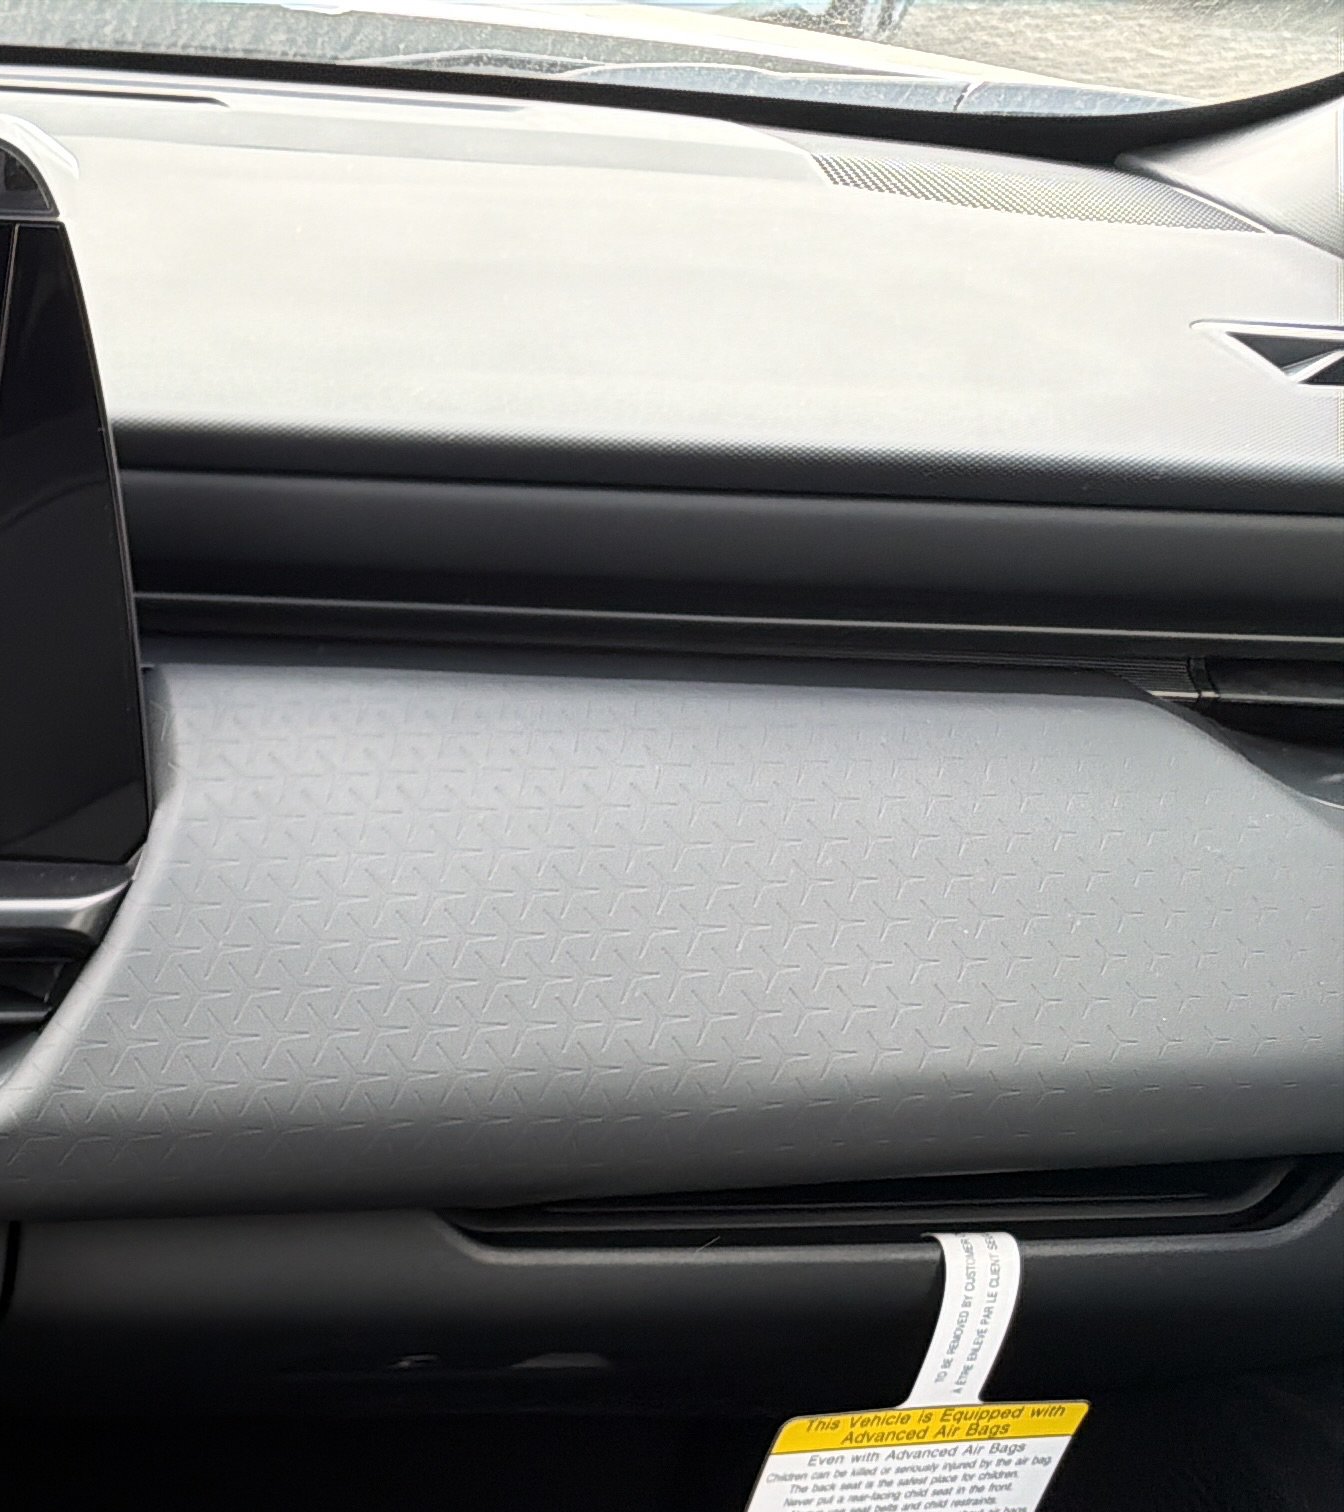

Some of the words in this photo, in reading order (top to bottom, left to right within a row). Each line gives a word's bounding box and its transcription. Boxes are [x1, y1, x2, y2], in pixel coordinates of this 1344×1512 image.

[806, 1416, 840, 1432] This
[851, 1412, 910, 1429] Vehicle
[918, 1411, 932, 1426] is
[941, 1406, 1024, 1426] Equipped
[1031, 1403, 1066, 1418] with
[841, 1426, 928, 1445] Advanced
[931, 1424, 960, 1442] Air
[964, 1423, 1009, 1440] Bags
[807, 1454, 845, 1468] Even
[851, 1451, 880, 1464] with
[885, 1445, 959, 1462] Advanced
[962, 1443, 985, 1457] Air
[989, 1441, 1026, 1456] Bags
